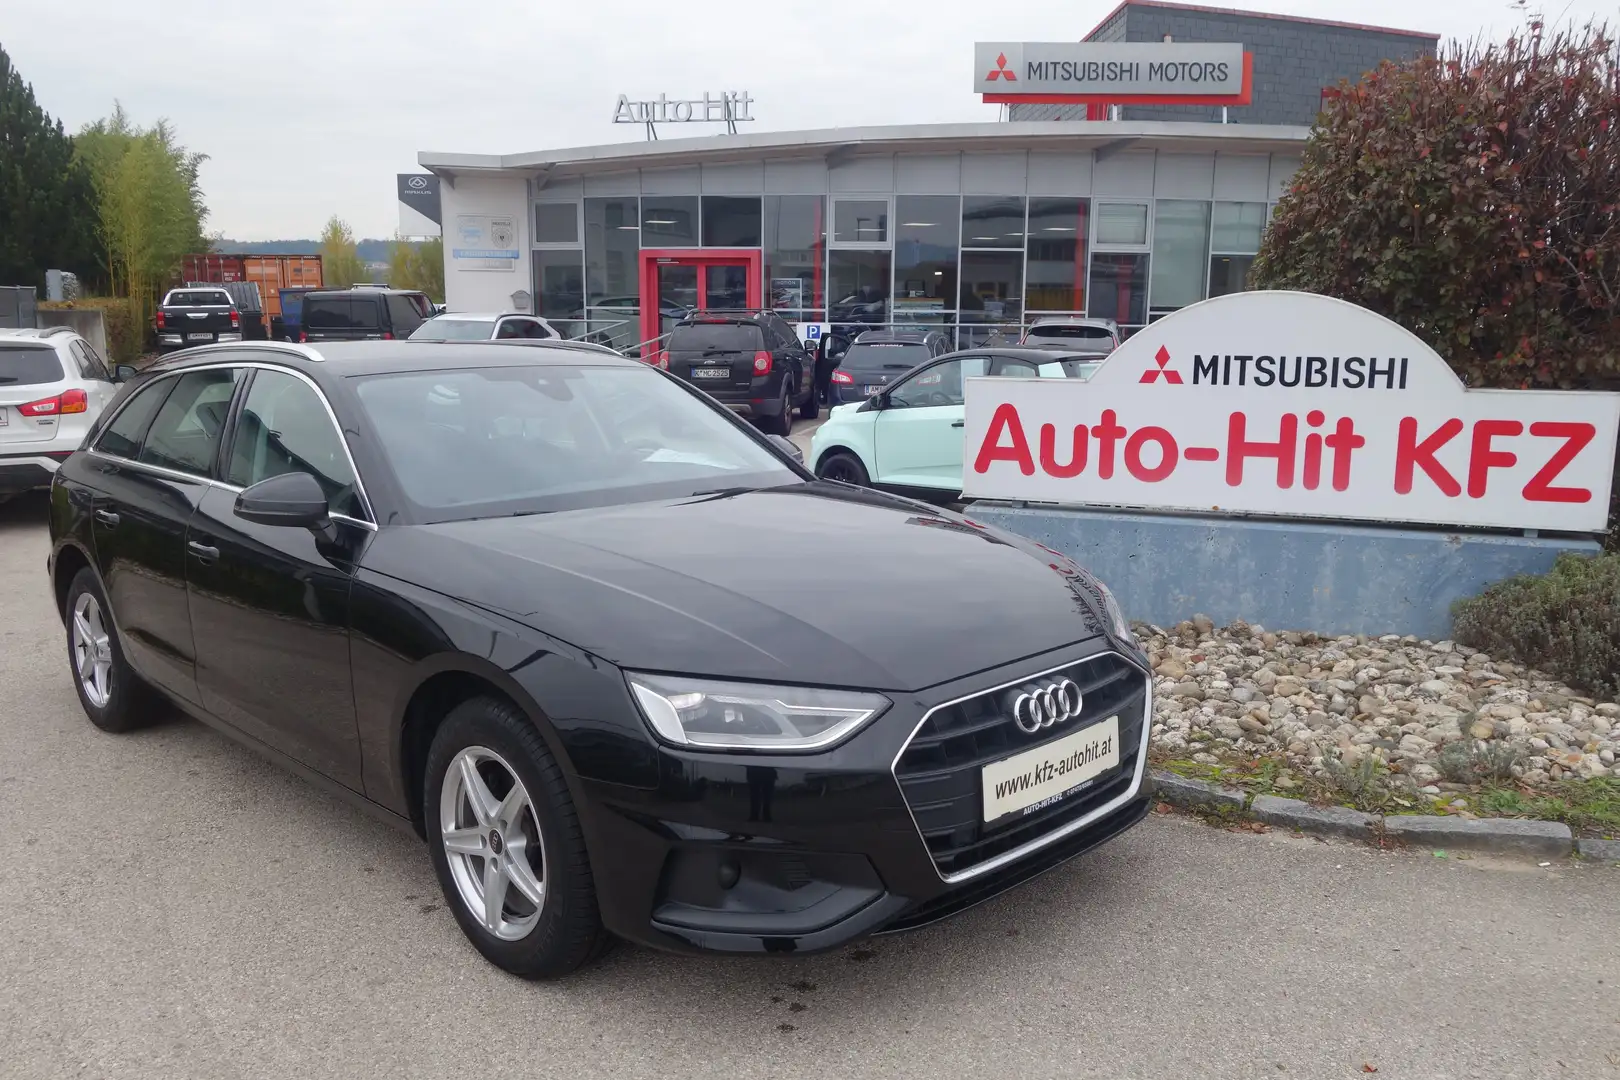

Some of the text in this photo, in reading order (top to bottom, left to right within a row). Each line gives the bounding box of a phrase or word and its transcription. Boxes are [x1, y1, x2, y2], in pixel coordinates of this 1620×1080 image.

[1027, 61, 1229, 83] MITSUBISHI MOTORS
[612, 90, 755, 123] Auto Hit
[809, 326, 818, 338] P
[1192, 354, 1409, 390] MITSUBISHI
[974, 403, 1596, 503] Auto-Hit KFZ
[995, 734, 1112, 800] www.kfz-autohit.at
[1023, 793, 1063, 816] AUTO-HIT-KFZ
